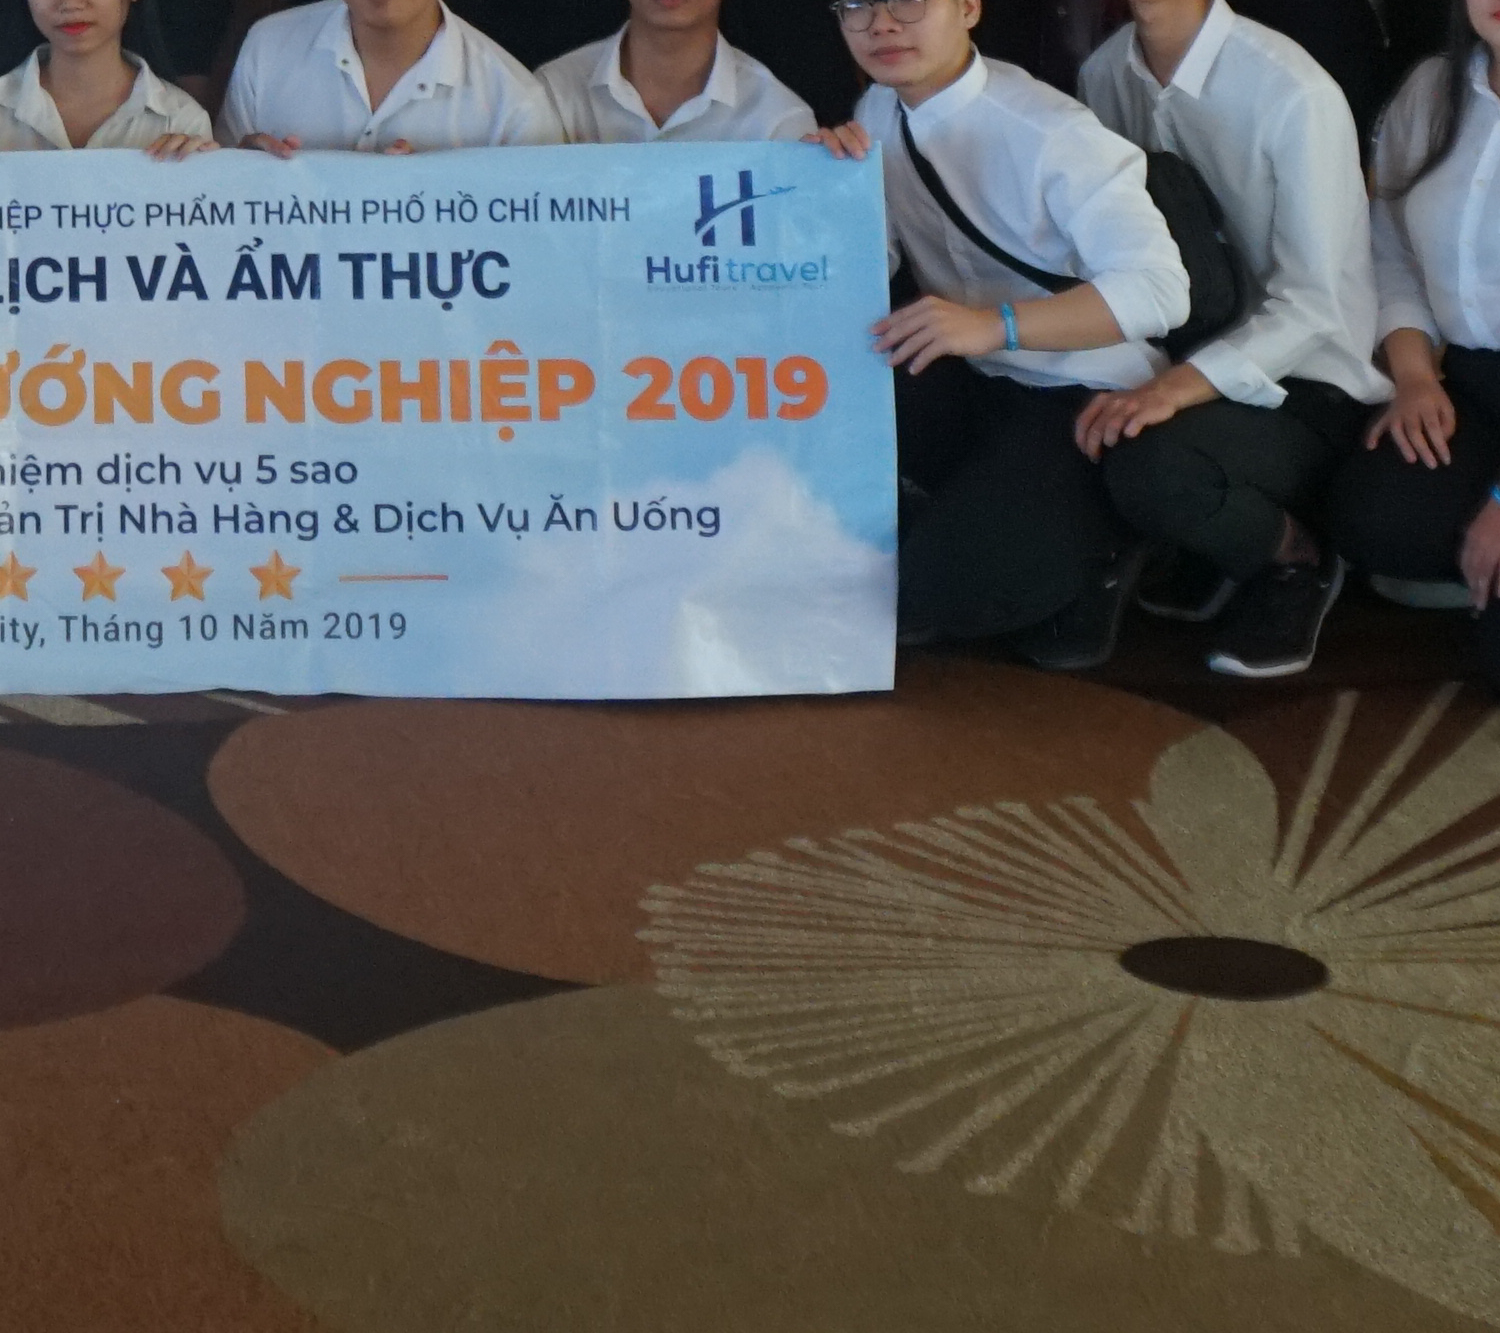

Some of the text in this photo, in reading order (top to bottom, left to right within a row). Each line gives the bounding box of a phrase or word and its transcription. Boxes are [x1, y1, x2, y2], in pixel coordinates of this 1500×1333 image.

[51, 202, 135, 234] THỰC
[146, 193, 235, 227] PHẨM
[244, 194, 351, 226] THÀNH
[362, 191, 425, 225] PHỐ
[436, 191, 478, 224] HỒ
[488, 191, 541, 223] CHÍ
[550, 197, 630, 223] MINH
[125, 242, 210, 302] VÀ
[225, 237, 321, 301] ẨM
[338, 249, 511, 312] THỰC
[245, 339, 596, 443] NGHIỆP
[623, 354, 829, 423] 2019
[96, 453, 182, 493] dịch
[195, 461, 242, 492] vụ
[256, 454, 278, 485] 5
[289, 461, 359, 485] sao
[54, 501, 104, 543] Trị
[120, 502, 198, 535] Nhà
[213, 503, 320, 541] Hàng
[333, 504, 361, 534] &
[373, 500, 465, 540] Dịch
[477, 502, 529, 540] Vụ
[543, 494, 598, 532] Ăn
[613, 495, 722, 537] Uống
[58, 614, 164, 648] Tháng
[178, 614, 218, 642] 10
[232, 611, 310, 641] Năm
[323, 612, 408, 641] 2019
